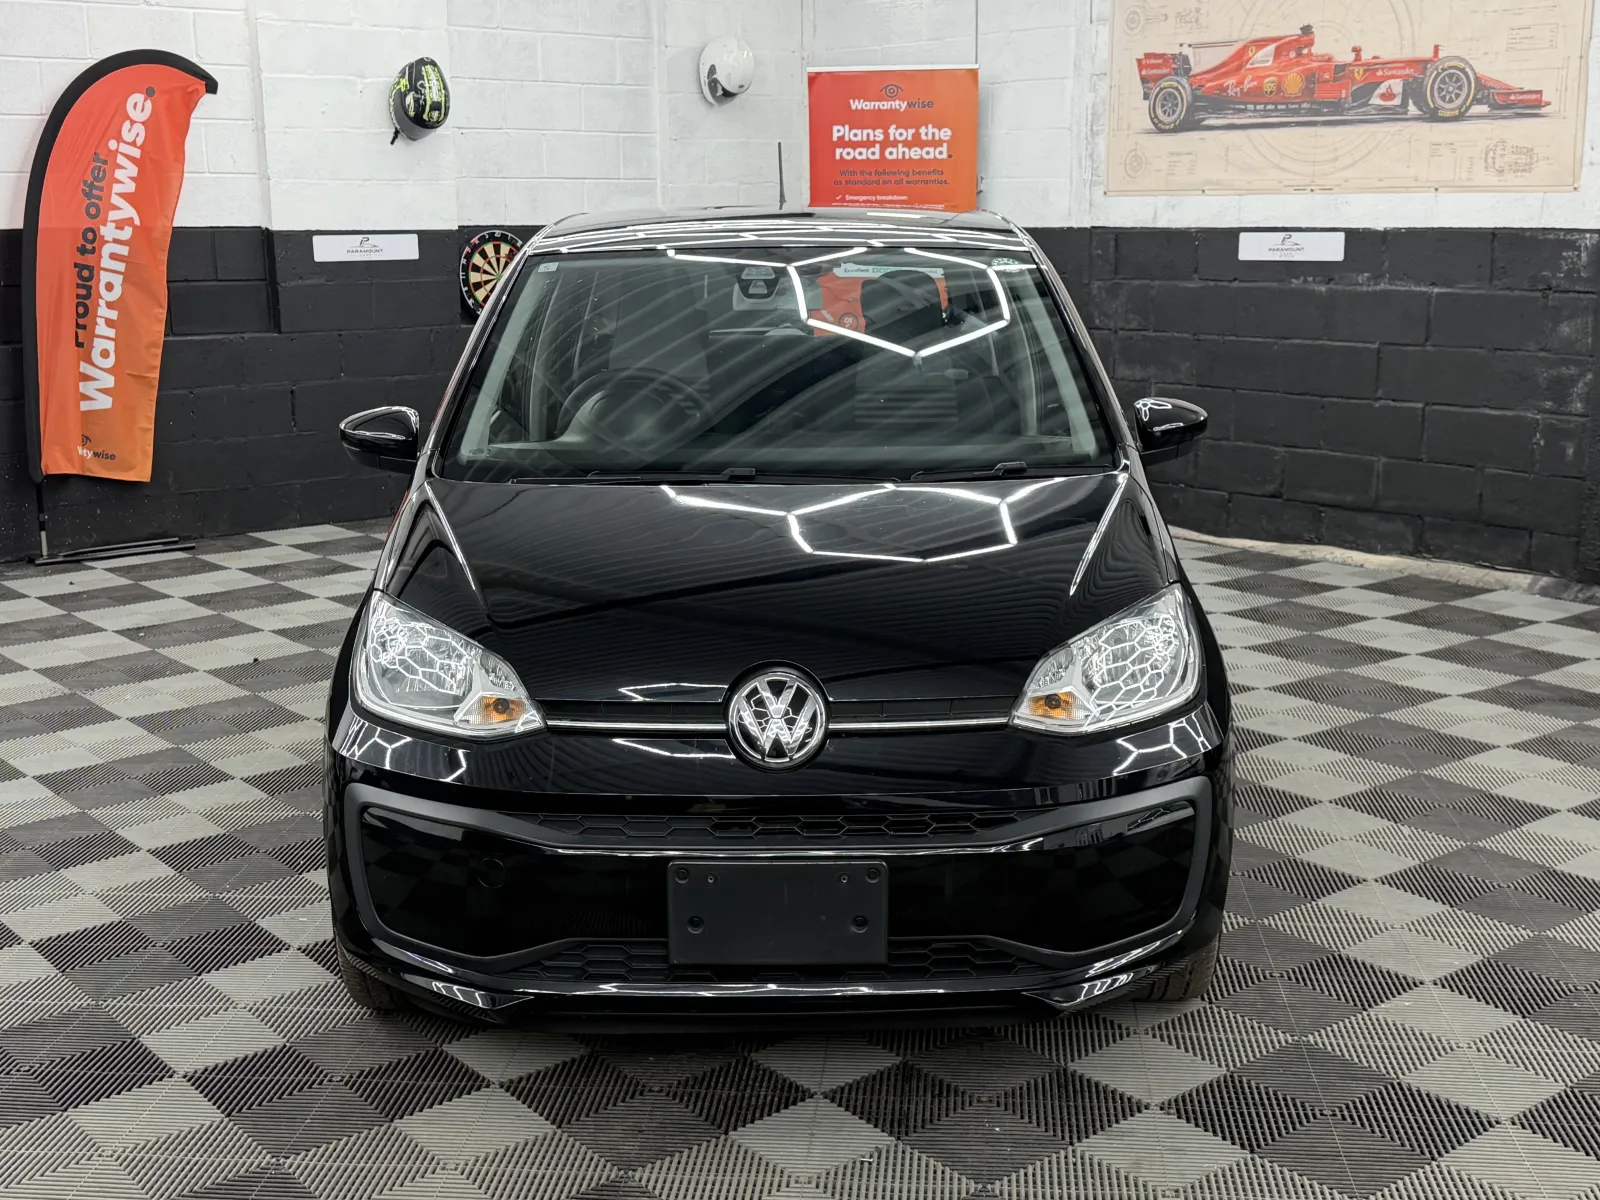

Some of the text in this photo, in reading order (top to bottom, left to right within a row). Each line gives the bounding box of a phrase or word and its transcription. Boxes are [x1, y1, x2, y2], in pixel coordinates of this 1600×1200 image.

[850, 98, 935, 112] Warrantywise
[832, 124, 953, 142] Plans for the
[835, 142, 953, 160] road ahead.
[840, 168, 944, 177] With the following benefits
[82, 152, 108, 219] offer
[845, 178, 880, 186] standard
[894, 178, 904, 186] all
[845, 194, 876, 202] Emergency
[76, 227, 97, 256] to
[79, 86, 156, 411] Warrantywise.
